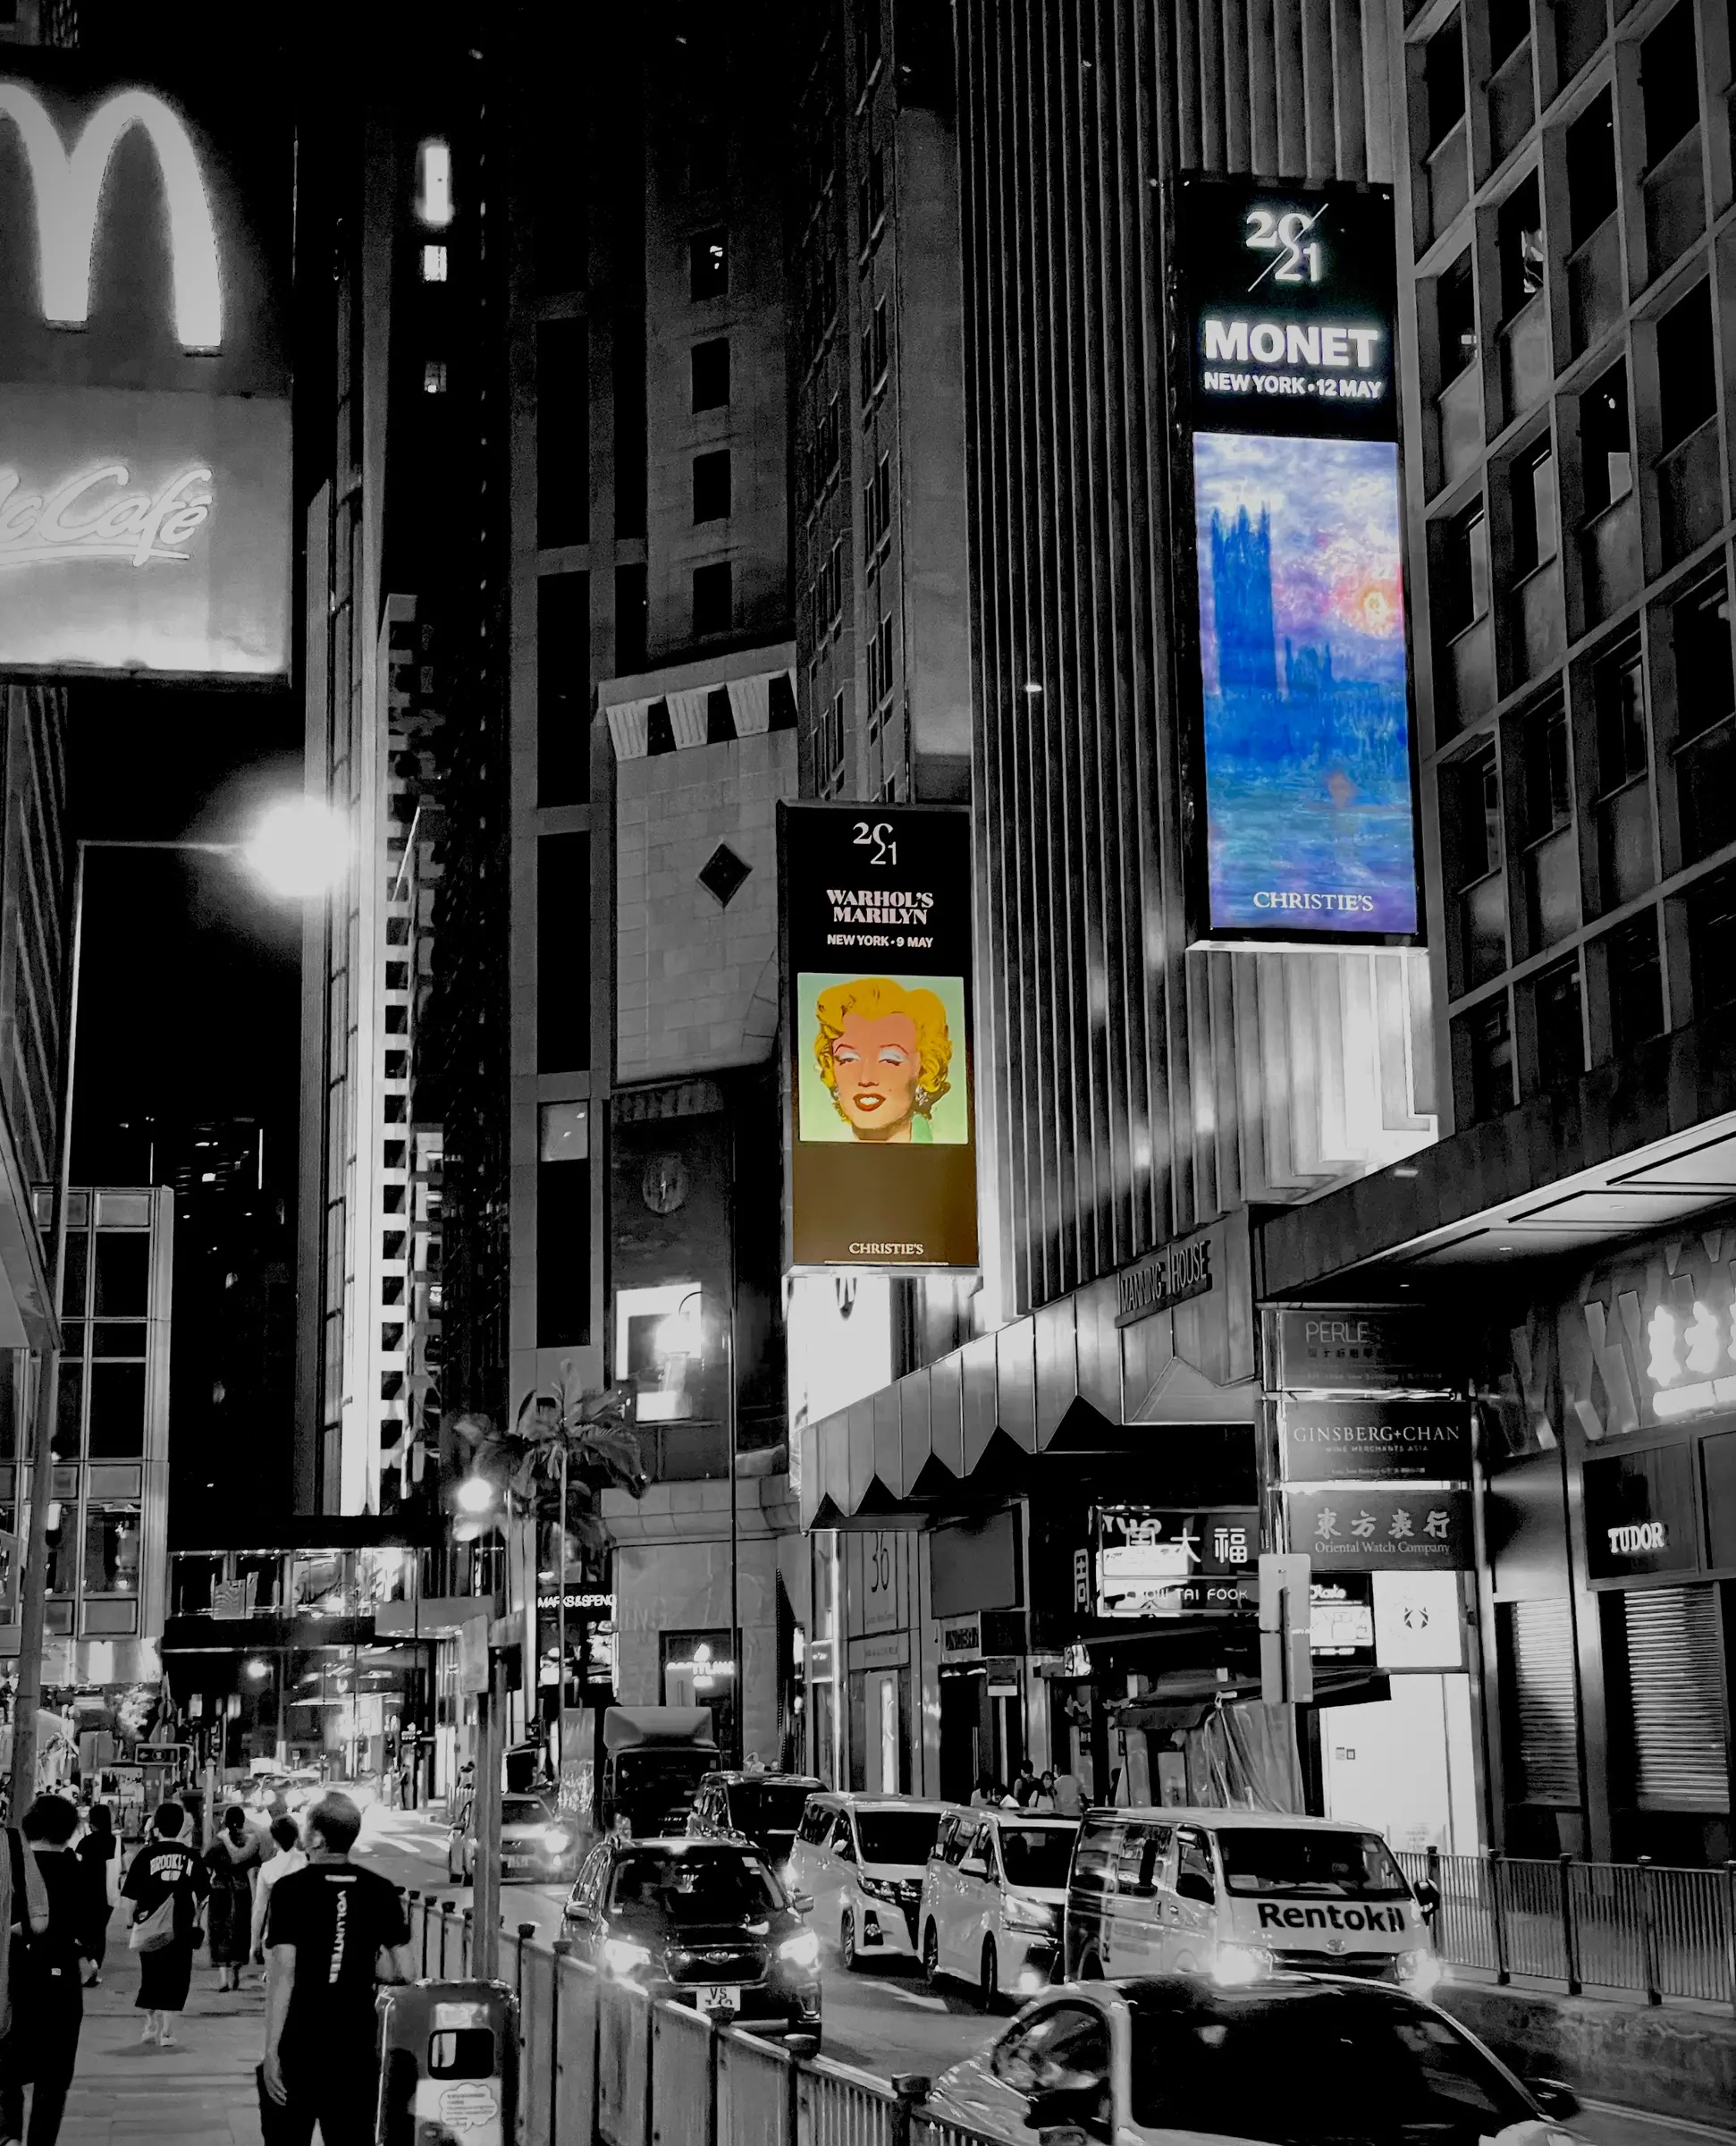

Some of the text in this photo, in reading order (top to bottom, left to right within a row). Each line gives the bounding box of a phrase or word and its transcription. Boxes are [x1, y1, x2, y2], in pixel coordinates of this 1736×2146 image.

[1205, 319, 1378, 368] MONET
[1204, 372, 1251, 392] NEW
[1339, 380, 1382, 399] MAY
[0, 465, 213, 567] cCafé
[1253, 891, 1374, 911] CHRISTIE'S
[833, 906, 928, 925] MARILYN
[827, 934, 855, 945] NEW
[896, 937, 905, 947] 9
[906, 936, 934, 948] MAY
[848, 1242, 924, 1255] CHRISTIE'S
[1170, 1240, 1207, 1294] HOUSE
[1306, 1321, 1384, 1343] PERLE
[1294, 1426, 1461, 1442] GINSBERG+CHAN
[1326, 1445, 1429, 1453] WINE MERCHANTS ASIA
[1314, 1508, 1451, 1540] 東方表行
[1315, 1542, 1451, 1556] Oriental Watch Company
[1608, 1522, 1664, 1554] TUDOR
[1176, 1589, 1200, 1601] TAI
[1207, 1588, 1248, 1601] FOOK
[150, 1854, 194, 1877] BROOKLN
[1258, 1903, 1404, 1933] Rentokil
